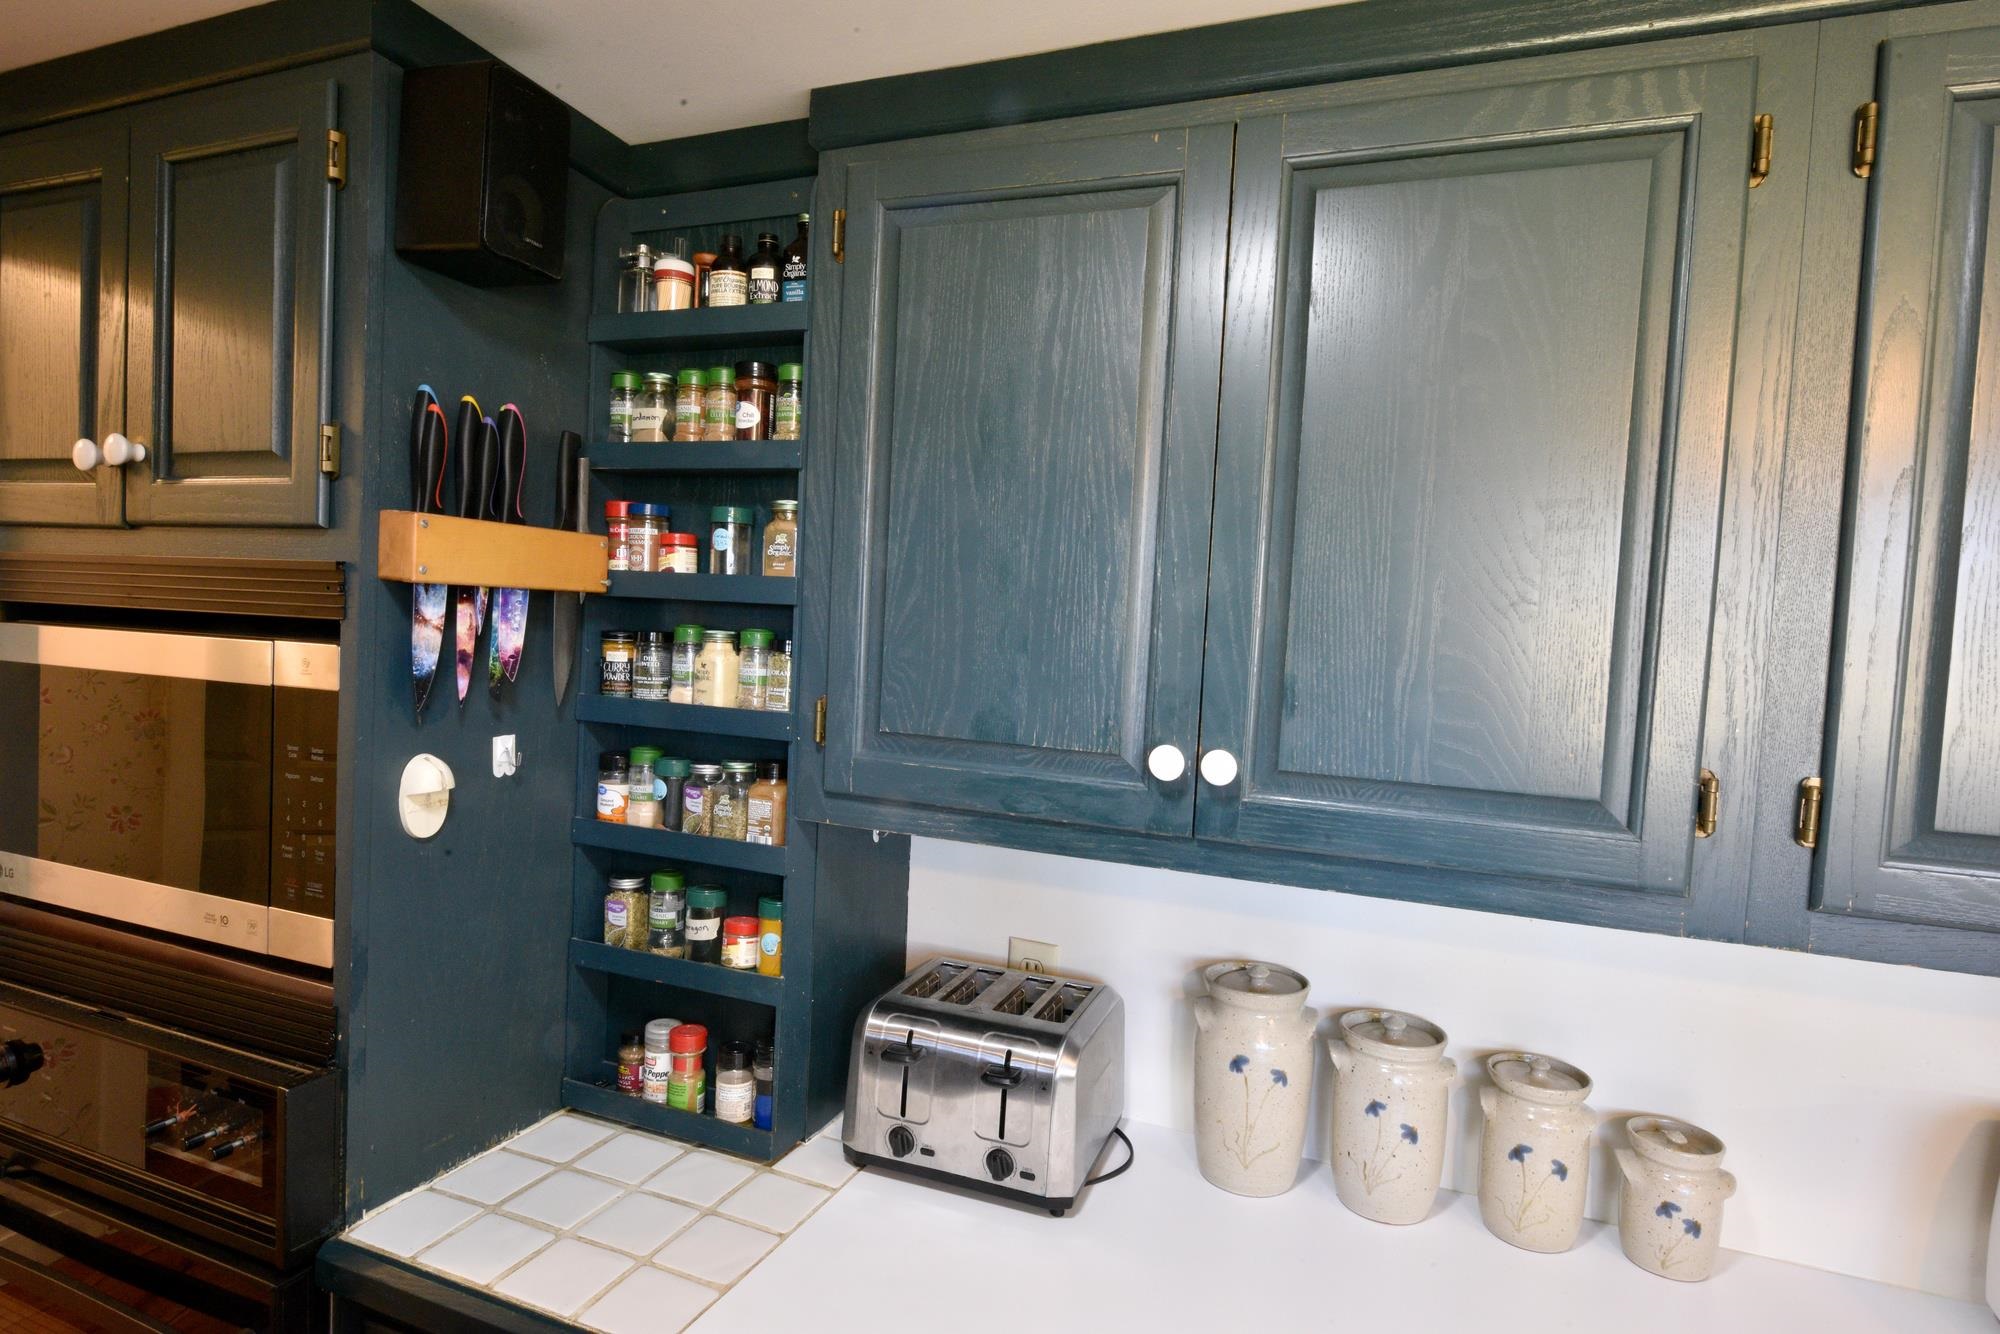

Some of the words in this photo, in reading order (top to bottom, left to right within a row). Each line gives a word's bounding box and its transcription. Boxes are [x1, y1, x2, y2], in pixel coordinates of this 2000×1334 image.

[783, 269, 806, 279] Organic
[784, 263, 806, 275] Simply
[749, 280, 779, 293] ALMOND
[749, 292, 777, 301] Extract
[603, 661, 630, 673] CURRY
[603, 671, 630, 681] POWDER
[4, 867, 14, 878] LG
[647, 1069, 670, 1079] Peppe
